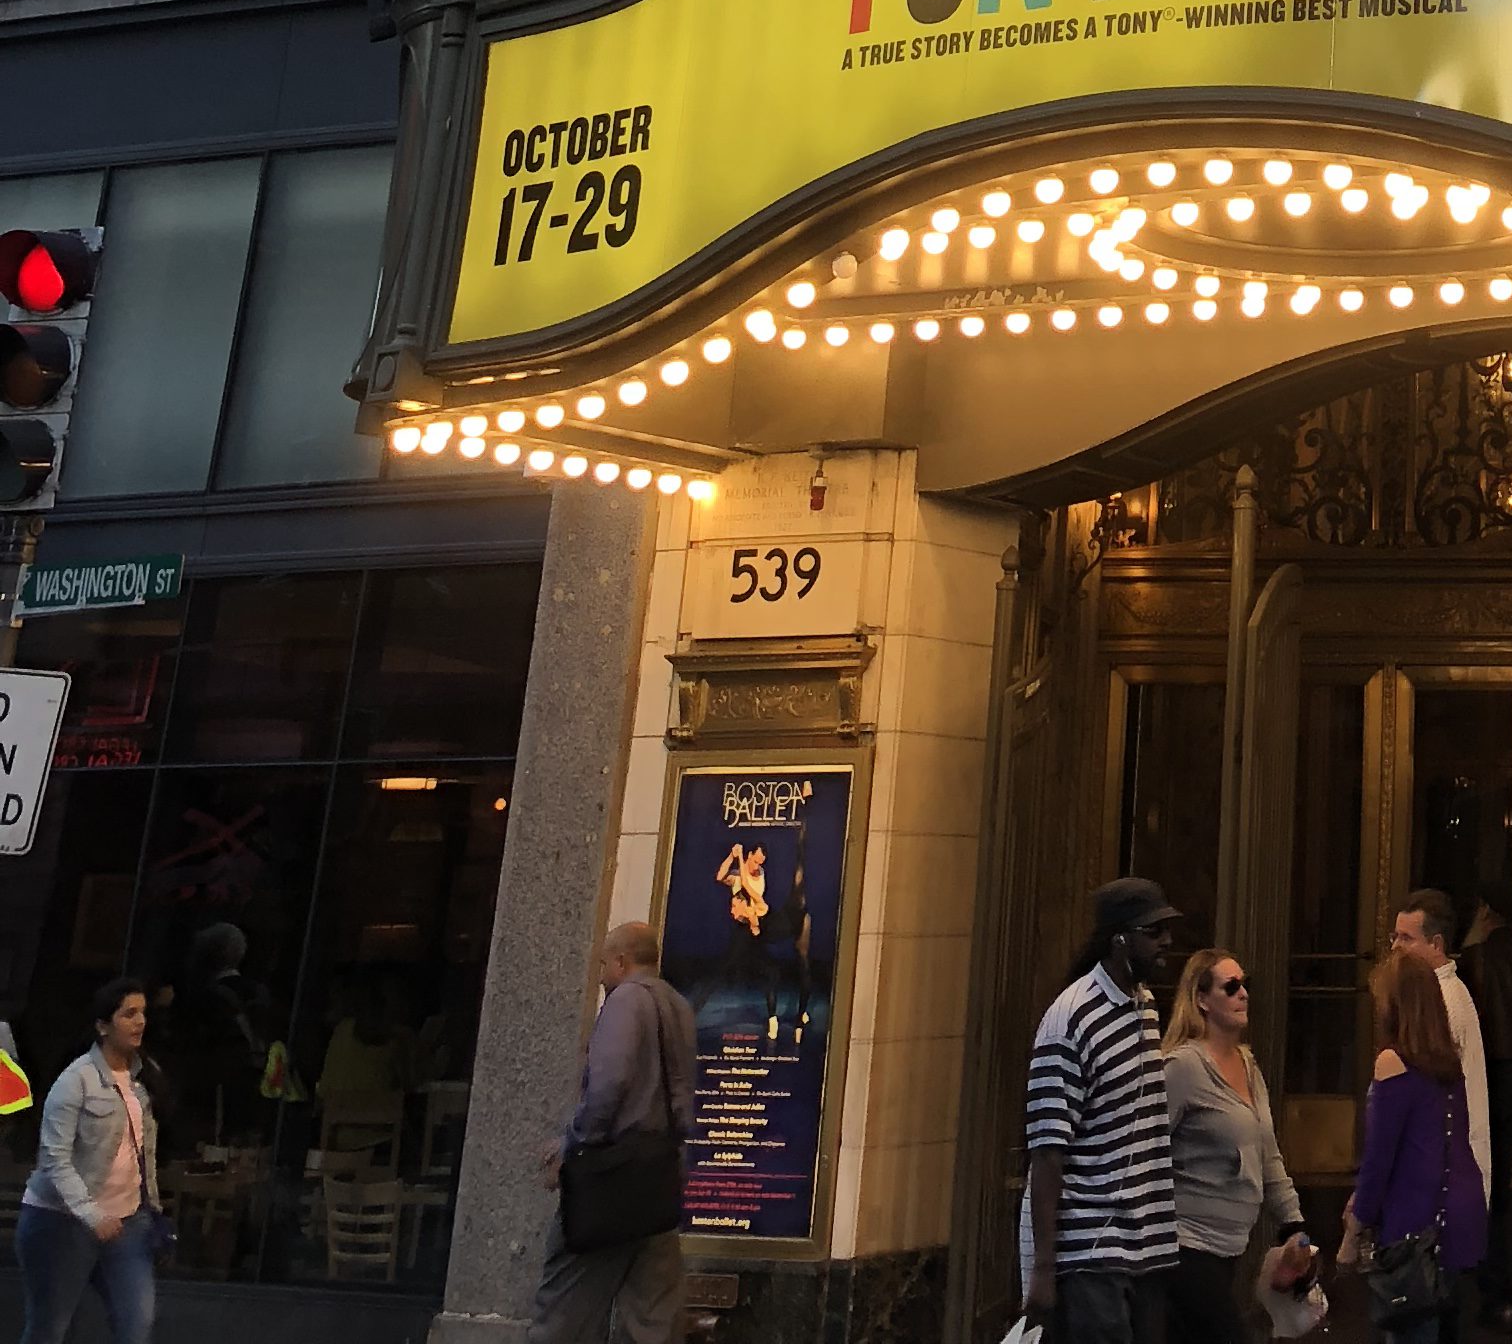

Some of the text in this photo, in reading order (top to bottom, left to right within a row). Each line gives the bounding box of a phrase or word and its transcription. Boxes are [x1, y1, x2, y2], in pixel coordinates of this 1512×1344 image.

[841, 48, 853, 71] A
[859, 39, 906, 68] TRUE
[911, 31, 975, 60] STORY
[979, 18, 1078, 51] BECOMES
[1083, 16, 1097, 40] A
[503, 105, 653, 177] OCTOBER
[494, 164, 642, 266] 17-29
[35, 563, 175, 603] WASHINGTON ST
[730, 547, 822, 604] 539
[723, 782, 807, 806] BOSTON
[724, 796, 804, 828] BALLET
